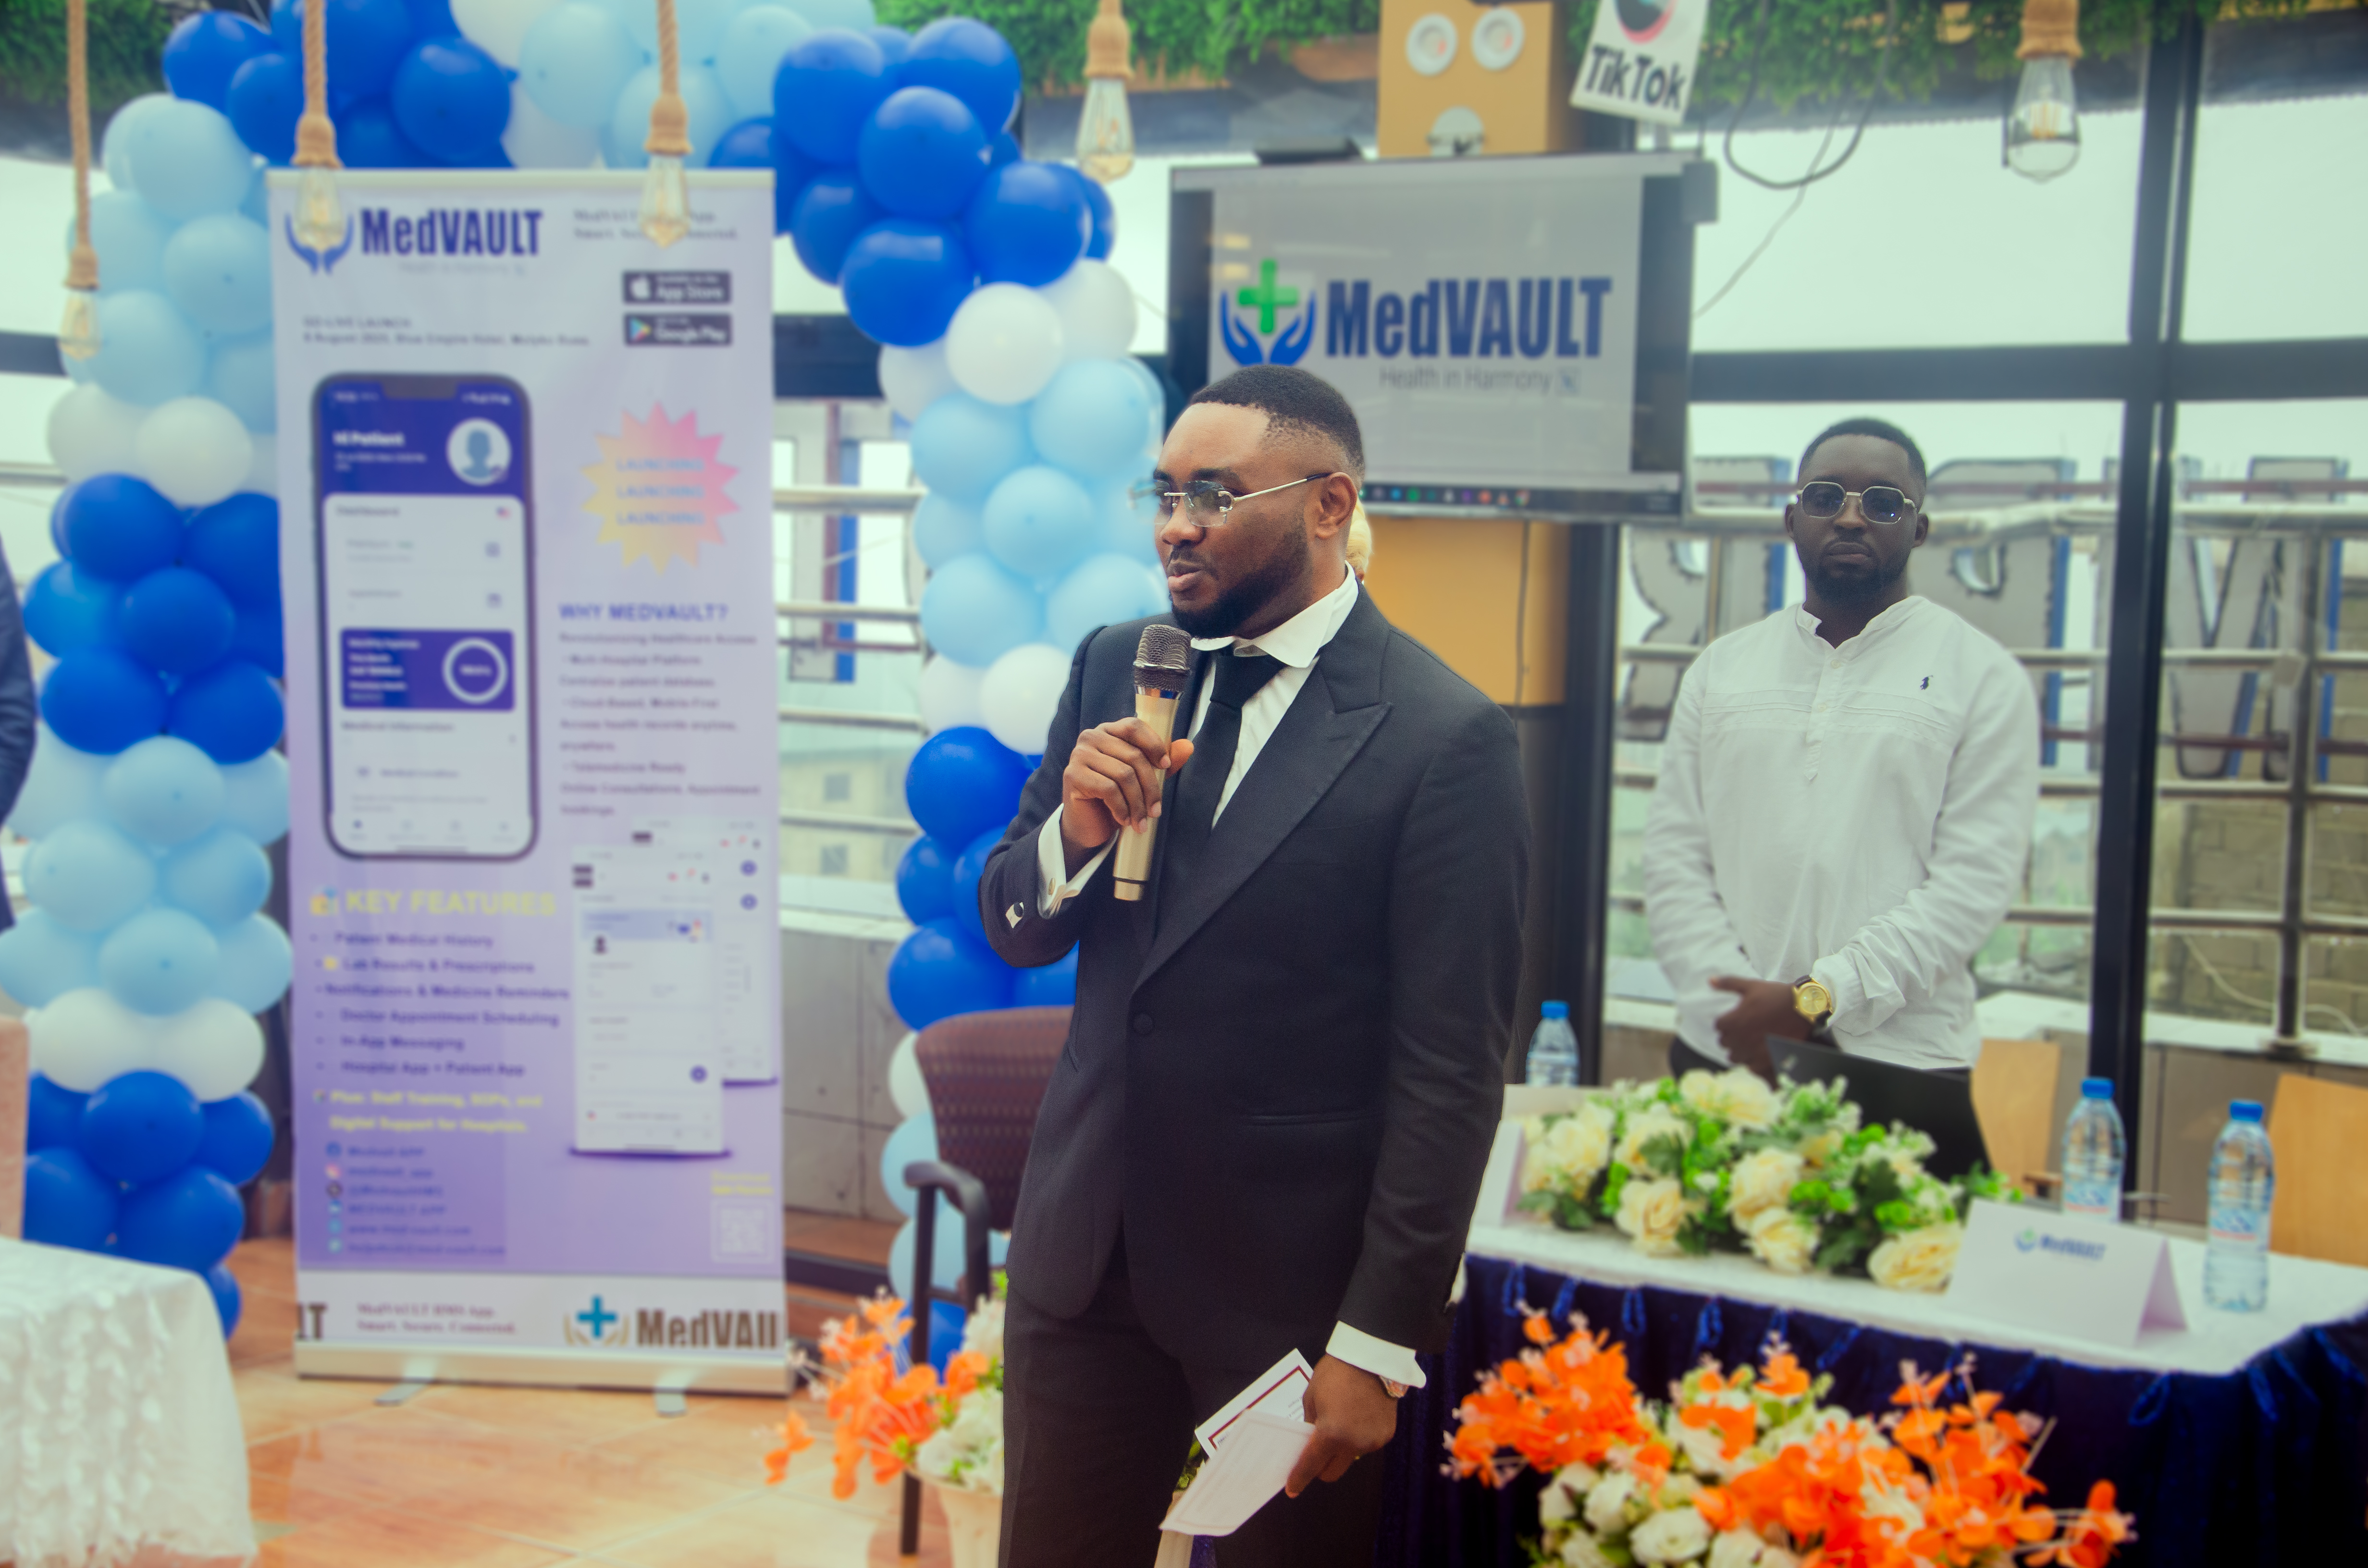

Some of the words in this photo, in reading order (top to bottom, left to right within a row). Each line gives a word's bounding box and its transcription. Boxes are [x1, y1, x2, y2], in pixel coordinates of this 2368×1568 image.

[1584, 43, 1686, 110] TikTok
[360, 208, 543, 257] MedVAULT
[656, 285, 684, 301] App
[686, 285, 724, 299] Store
[1325, 276, 1613, 359] MedVAULT
[655, 326, 698, 343] Google
[701, 327, 726, 343] Play
[1378, 366, 1437, 391] Health
[1465, 366, 1554, 397] Harmony
[334, 432, 349, 446] Hi
[351, 432, 405, 447] Patient
[617, 458, 705, 472] LAUNCHING
[617, 485, 705, 499] LAUNCHING
[617, 511, 705, 526] LAUNCHING
[559, 604, 603, 621] WHY
[609, 604, 728, 621] MEDVAULT?
[347, 890, 403, 913] KEY
[412, 891, 557, 915] FEATURES
[335, 932, 382, 946] Patient
[387, 934, 439, 946] Medical
[444, 935, 493, 949] History
[344, 958, 369, 971] Lab
[373, 959, 425, 971] Results
[443, 960, 535, 975] Prescriptions
[326, 983, 413, 997] Notifications
[432, 986, 493, 998] Medicine
[497, 987, 570, 1000] Reminders
[342, 1009, 386, 1022] Doctor
[390, 1010, 479, 1025] Appointment
[482, 1011, 559, 1028] Scheduling
[390, 1037, 465, 1051] Messaging
[342, 1061, 398, 1075] Hospital
[402, 1062, 430, 1076] App
[446, 1062, 493, 1075] Patient
[498, 1064, 525, 1077] App
[371, 1091, 403, 1104] Staff
[517, 1095, 542, 1107] and
[331, 1115, 376, 1132] Digital
[379, 1116, 433, 1132] Support
[438, 1118, 458, 1130] for
[358, 1303, 429, 1317] MedVAULT
[433, 1305, 465, 1317] HMS
